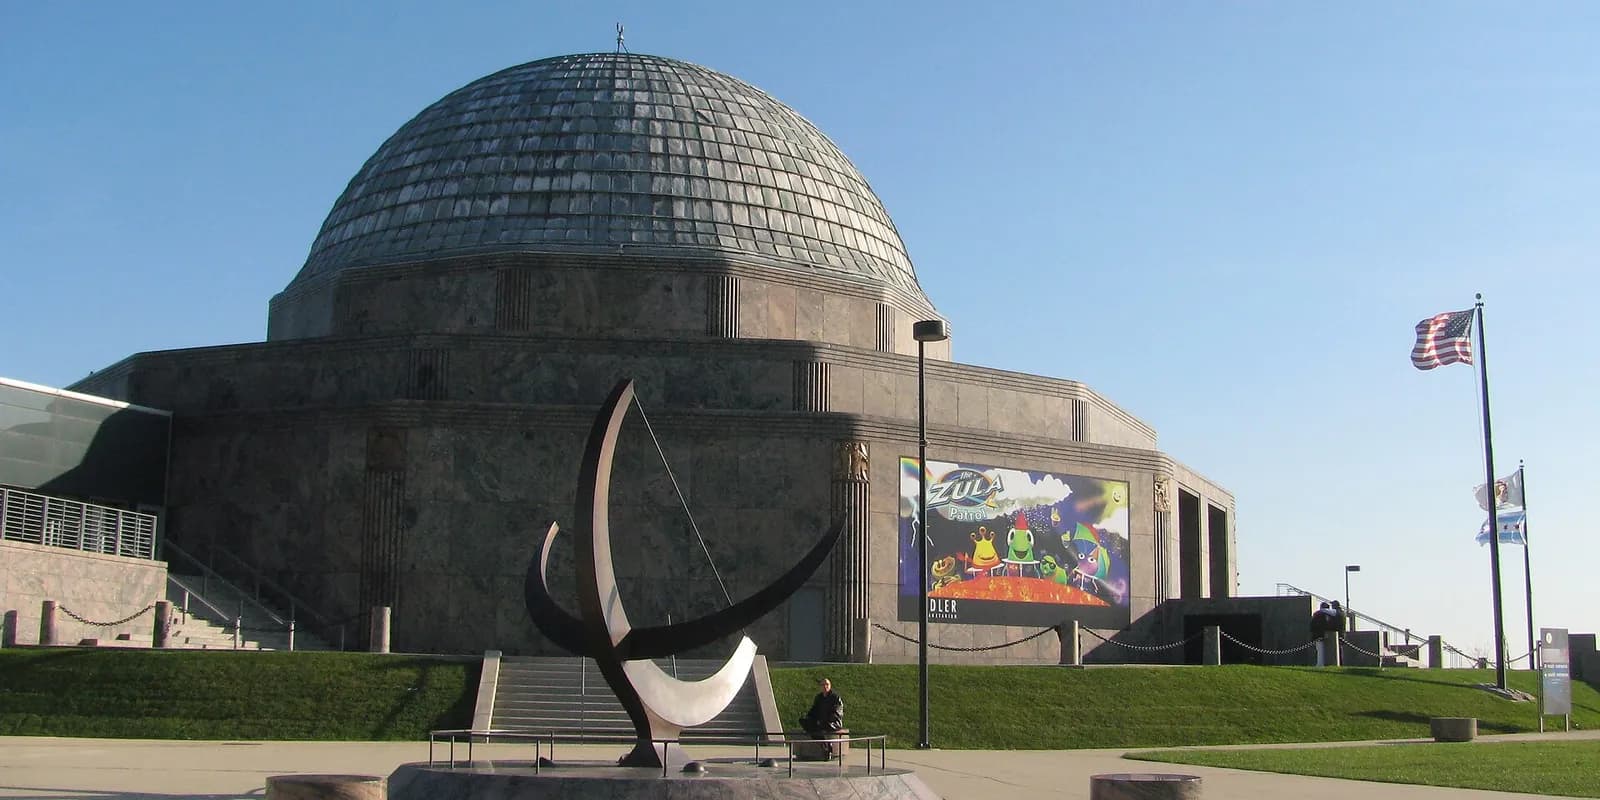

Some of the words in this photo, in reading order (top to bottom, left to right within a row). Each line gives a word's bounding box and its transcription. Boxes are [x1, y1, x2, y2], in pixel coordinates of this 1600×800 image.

[927, 475, 1003, 508] ZULA
[950, 507, 987, 520] Patrol
[930, 599, 957, 613] DLER
